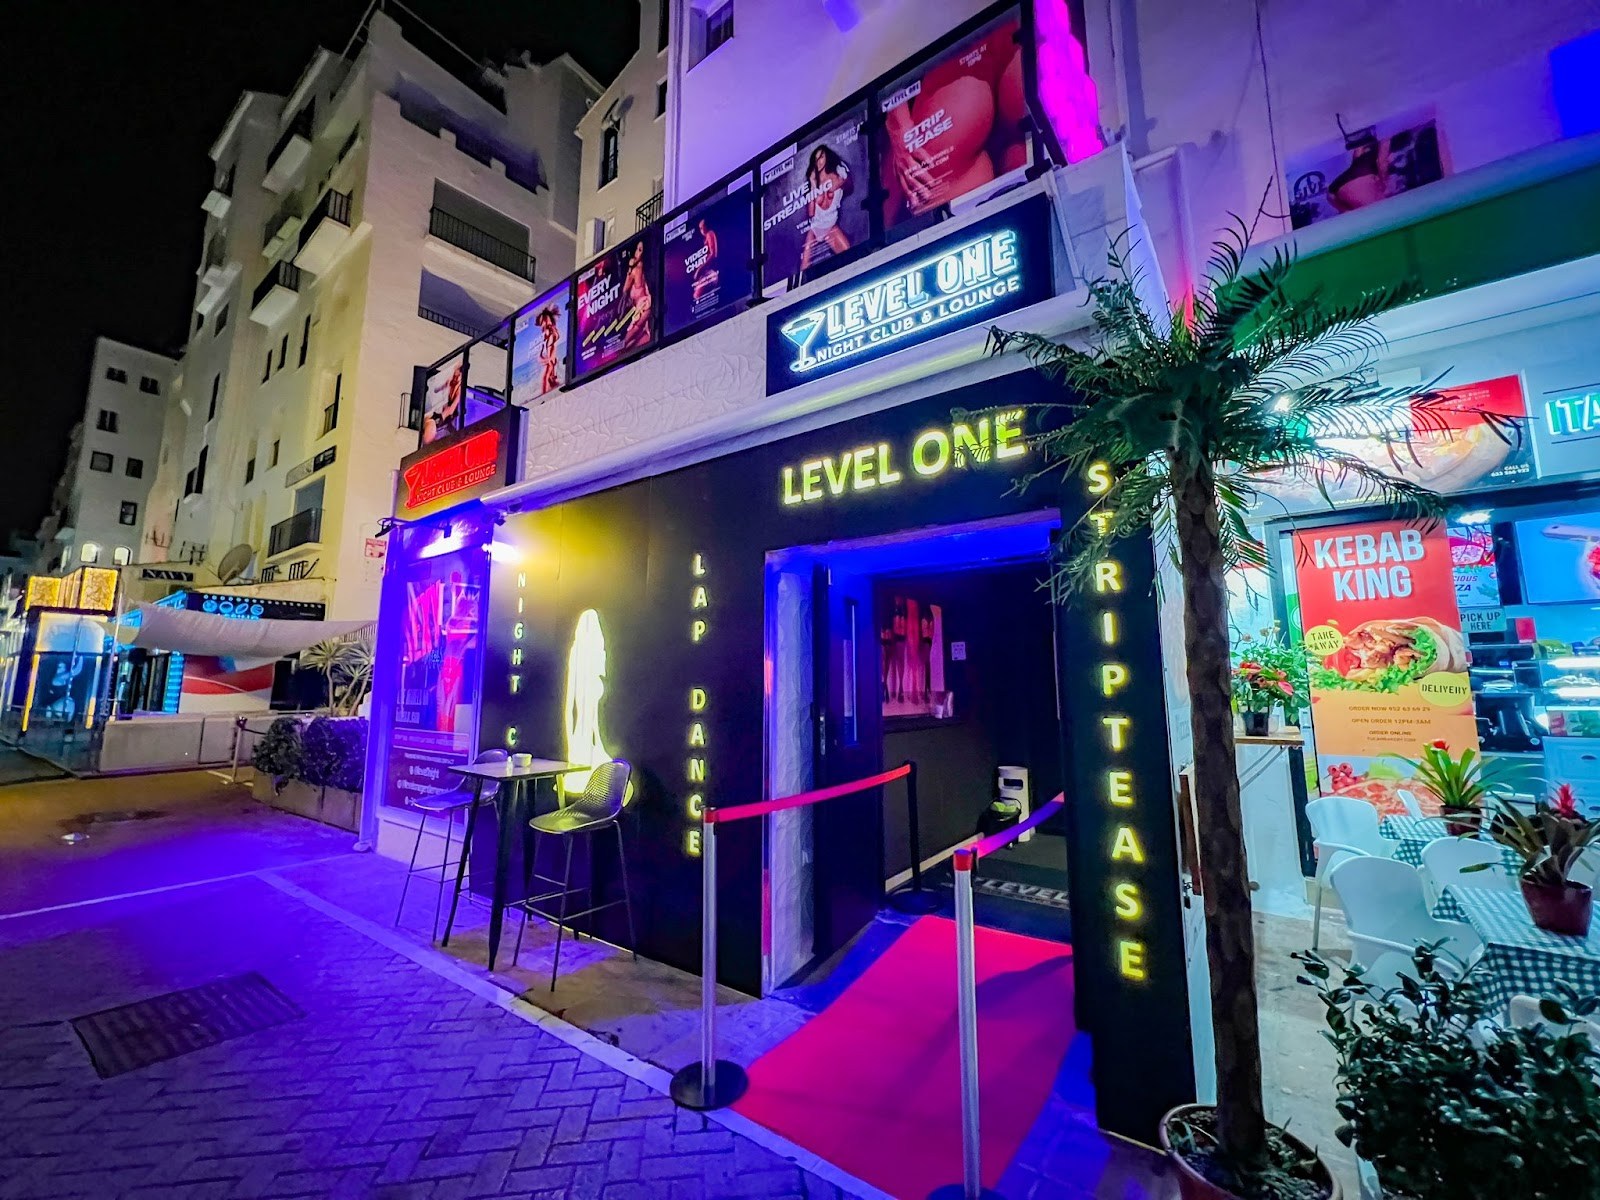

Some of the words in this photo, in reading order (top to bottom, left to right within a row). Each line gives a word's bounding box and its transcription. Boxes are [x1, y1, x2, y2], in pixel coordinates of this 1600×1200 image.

[903, 108, 946, 143] STRIP
[905, 116, 954, 153] TEASE
[763, 179, 833, 231] STREAMING
[783, 180, 811, 207] LIVE
[684, 245, 709, 267] VIDEO
[686, 256, 708, 274] CHAT
[577, 274, 612, 310] EVERY
[586, 283, 621, 319] NIGHT
[826, 271, 929, 339] LEVEL
[937, 230, 1017, 293] ONE
[816, 336, 864, 362] NIGHT
[870, 316, 914, 342] CLUB
[921, 309, 933, 325] &
[939, 275, 1020, 317] LOUNGE
[464, 464, 496, 485] LOUNGE
[783, 444, 901, 505] LEVEL
[912, 409, 1027, 476] ONE
[1314, 528, 1425, 570] KEBAB
[144, 570, 193, 581] NAVY
[1333, 565, 1413, 602] KING
[692, 553, 709, 643] LAP
[509, 571, 527, 695] NIGHT
[1311, 630, 1335, 640] TAKE
[1460, 613, 1484, 622] PICK
[1486, 612, 1501, 621] UP
[1470, 621, 1492, 631] HERE
[1313, 639, 1340, 651] AWAY
[1421, 683, 1468, 695] DELIVERY
[1087, 461, 1146, 979] STRIPTEASE
[688, 688, 707, 856] DANCE
[982, 879, 1070, 901] LEVEL
